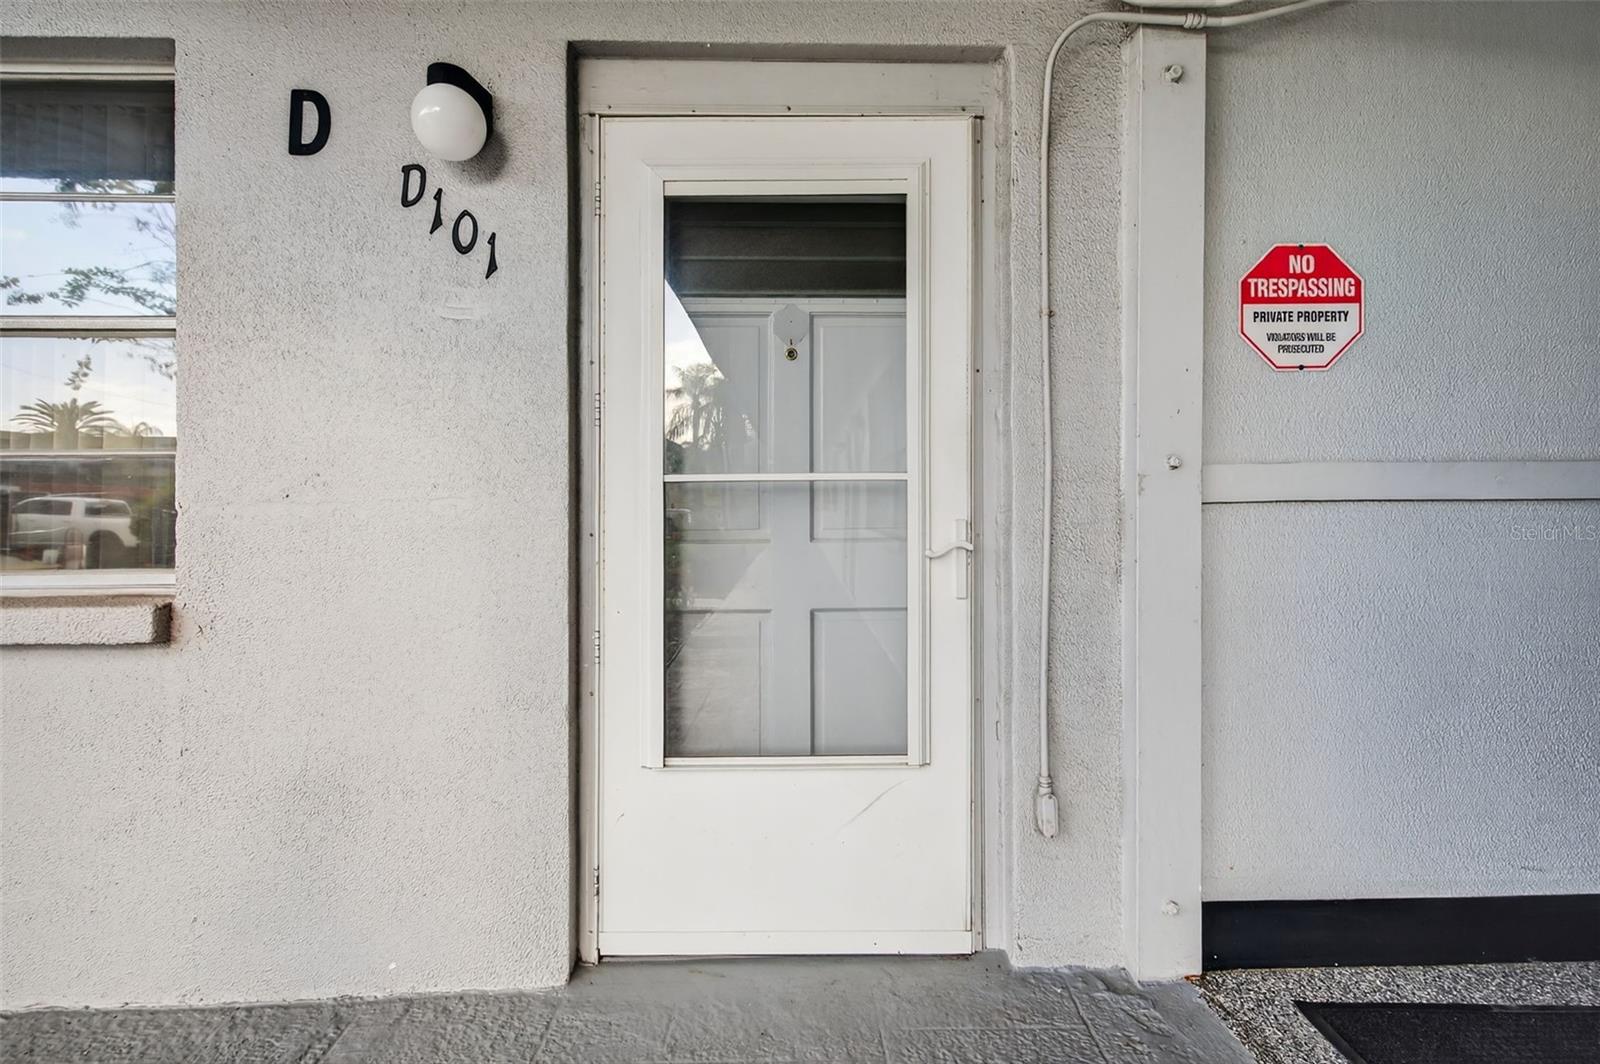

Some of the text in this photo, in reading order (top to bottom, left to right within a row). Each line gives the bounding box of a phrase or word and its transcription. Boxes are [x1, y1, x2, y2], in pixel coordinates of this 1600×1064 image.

[288, 88, 331, 156] D
[401, 163, 498, 280] D101
[1288, 254, 1315, 274] NO
[1247, 277, 1356, 298] TRESPASSING
[1253, 310, 1349, 323] PRIVATE PROPERTY
[1266, 332, 1336, 342] VIOLATORS WILL BE
[1277, 344, 1325, 353] PROSECUTED
